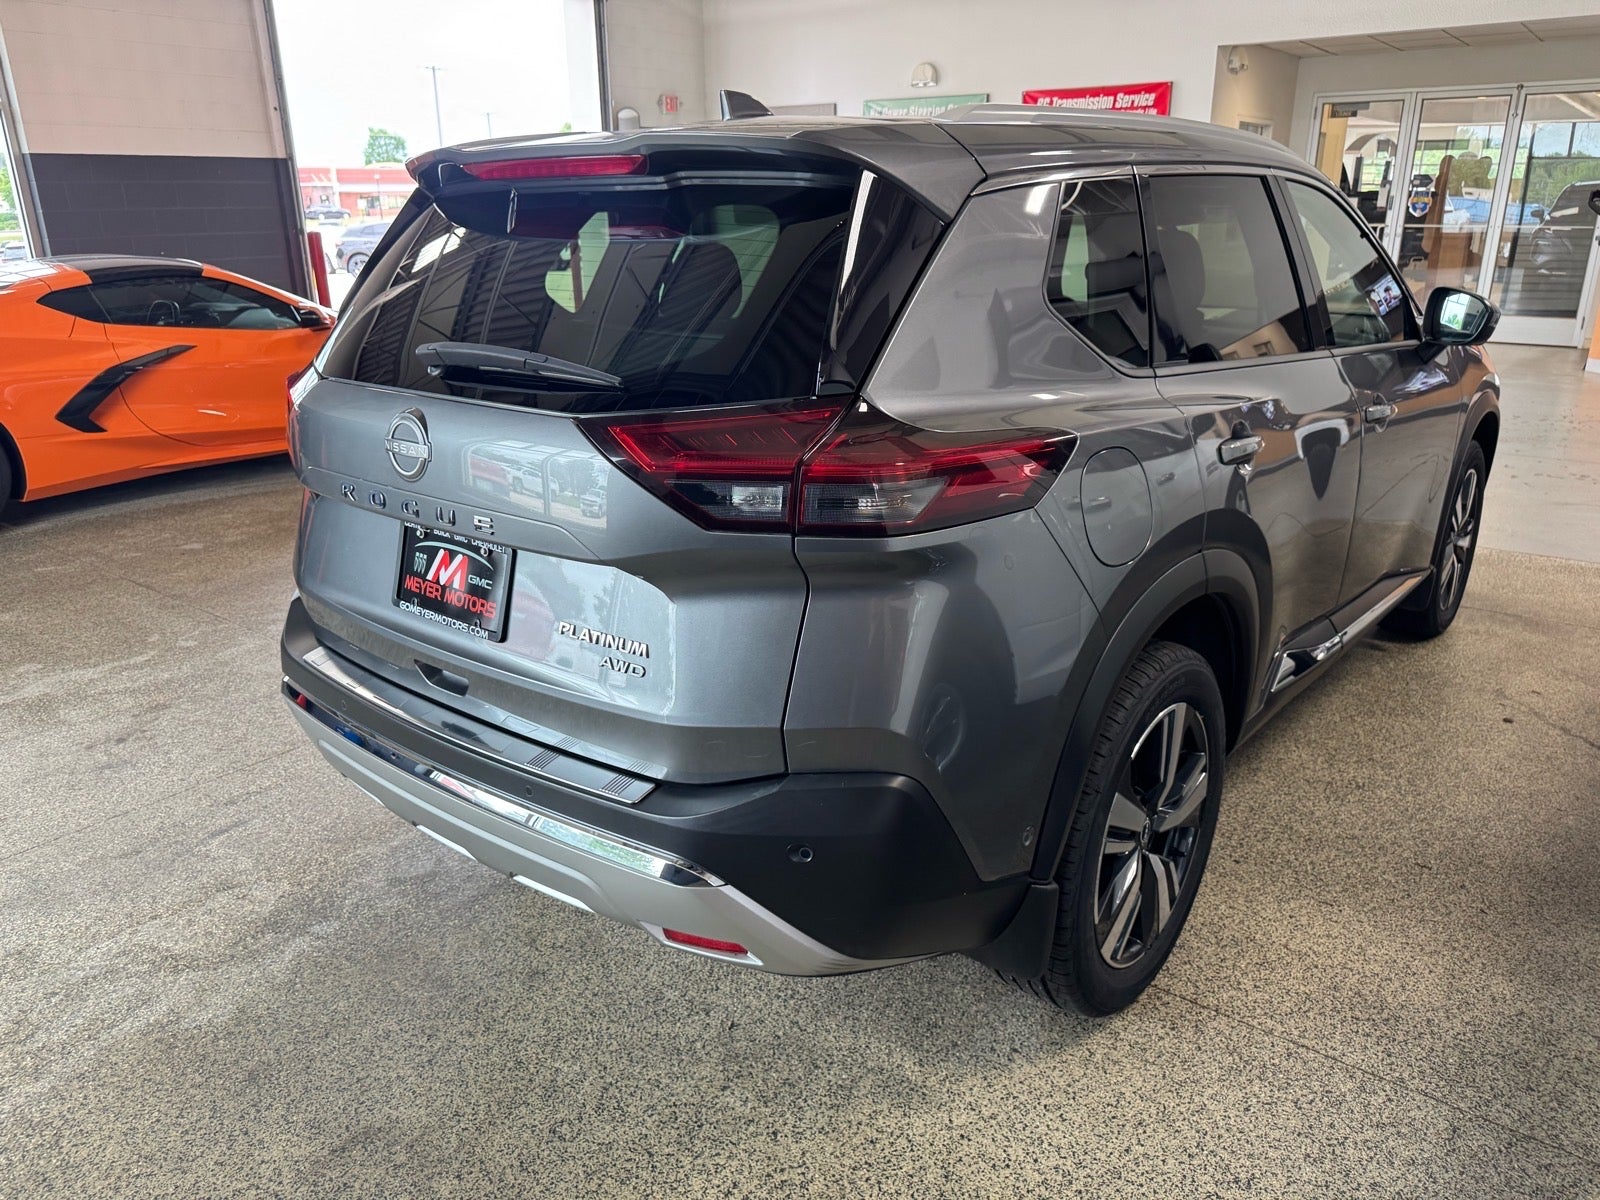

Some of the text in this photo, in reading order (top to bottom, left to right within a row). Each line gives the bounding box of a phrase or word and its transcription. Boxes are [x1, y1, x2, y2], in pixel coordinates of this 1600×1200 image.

[1052, 94, 1114, 110] Transmission
[1114, 91, 1156, 108] Service
[385, 439, 428, 457] NISSAN
[340, 480, 495, 536] ROGUE
[405, 574, 497, 618] MEYER MOTORS
[468, 574, 493, 590] GMC
[399, 600, 489, 640] GOMEYERMOTORS.COM
[558, 620, 650, 659] PLATINUM
[599, 656, 647, 678] AWD
